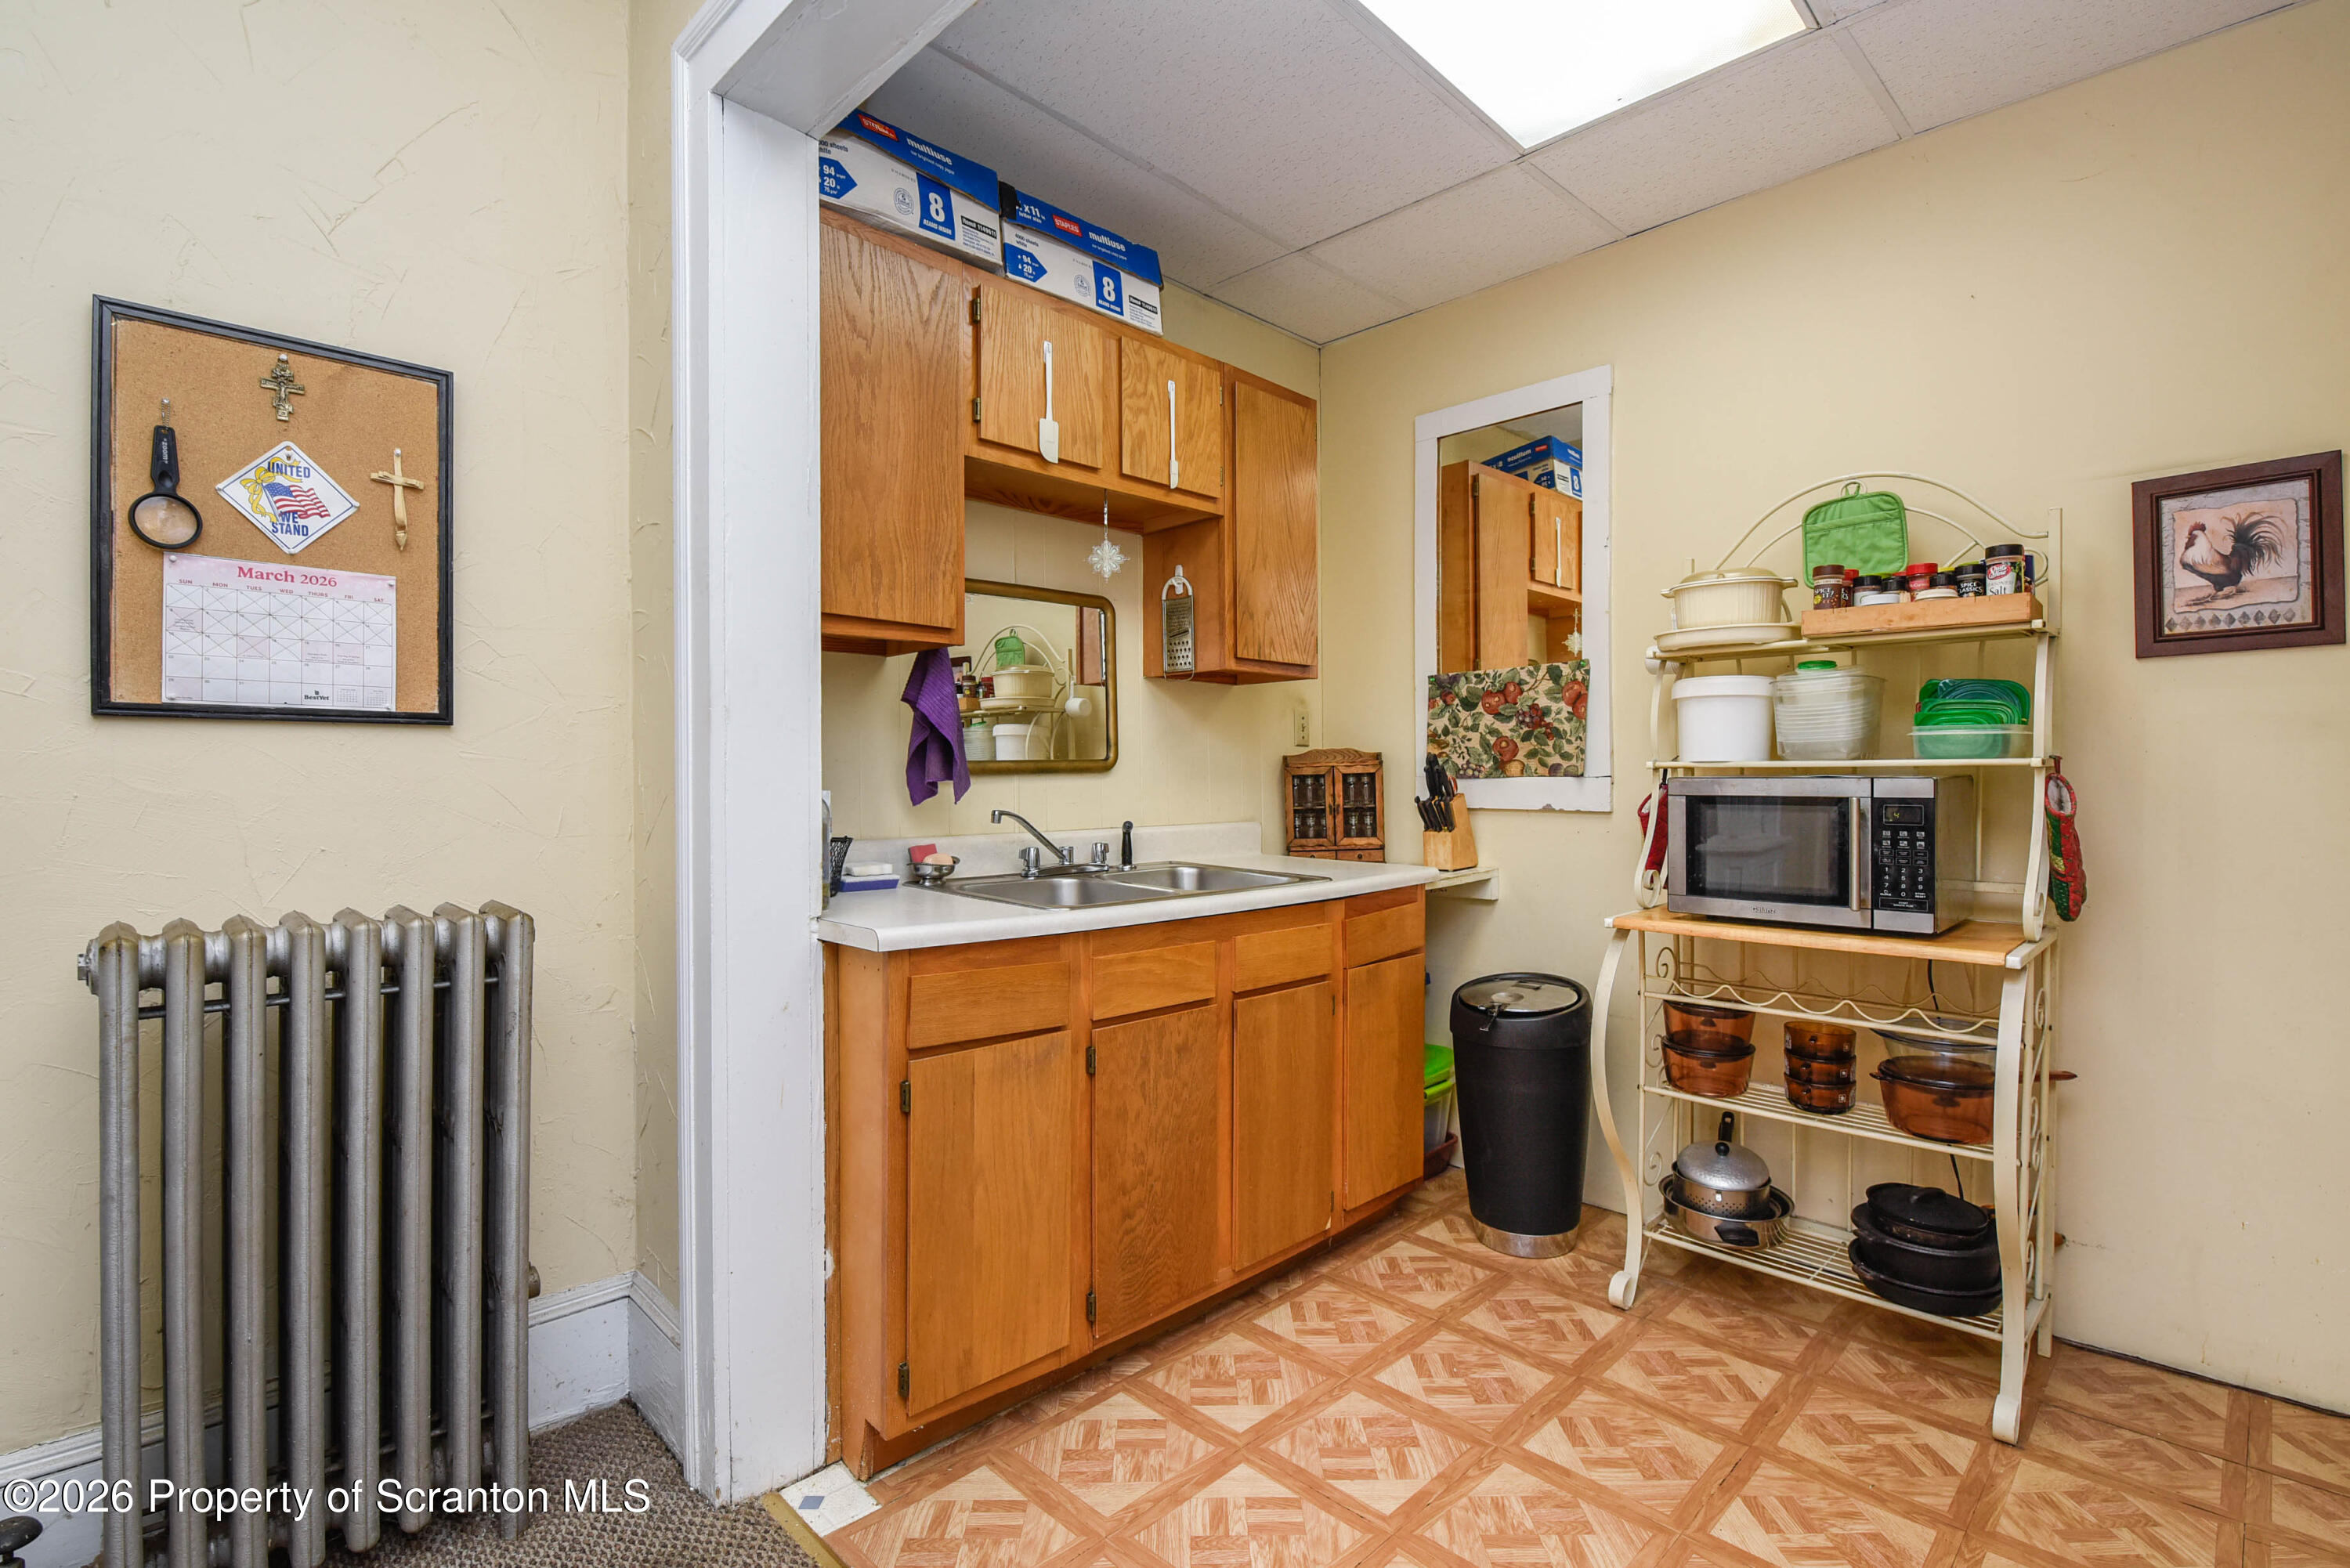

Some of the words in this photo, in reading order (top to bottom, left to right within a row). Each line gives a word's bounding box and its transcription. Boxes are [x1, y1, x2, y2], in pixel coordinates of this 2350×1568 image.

[829, 143, 848, 152] sheets
[906, 138, 953, 165] multiuse
[822, 164, 835, 176] 94
[823, 177, 836, 188] 20
[928, 192, 945, 222] 8
[1018, 211, 1032, 220] letter
[923, 219, 938, 229] REAMS
[938, 225, 953, 235] INSIDE
[1054, 218, 1079, 233] STAPLES
[1025, 237, 1039, 247] sheets
[1088, 231, 1126, 251] multiuse
[1022, 255, 1032, 265] 94
[1023, 264, 1032, 274] 20
[1102, 276, 1115, 302] 8
[267, 461, 311, 479] UNITED
[280, 511, 299, 524] WE
[271, 522, 309, 537] STAND
[237, 565, 295, 583] March
[300, 573, 338, 587] 2026
[1990, 586, 2007, 595] Salt
